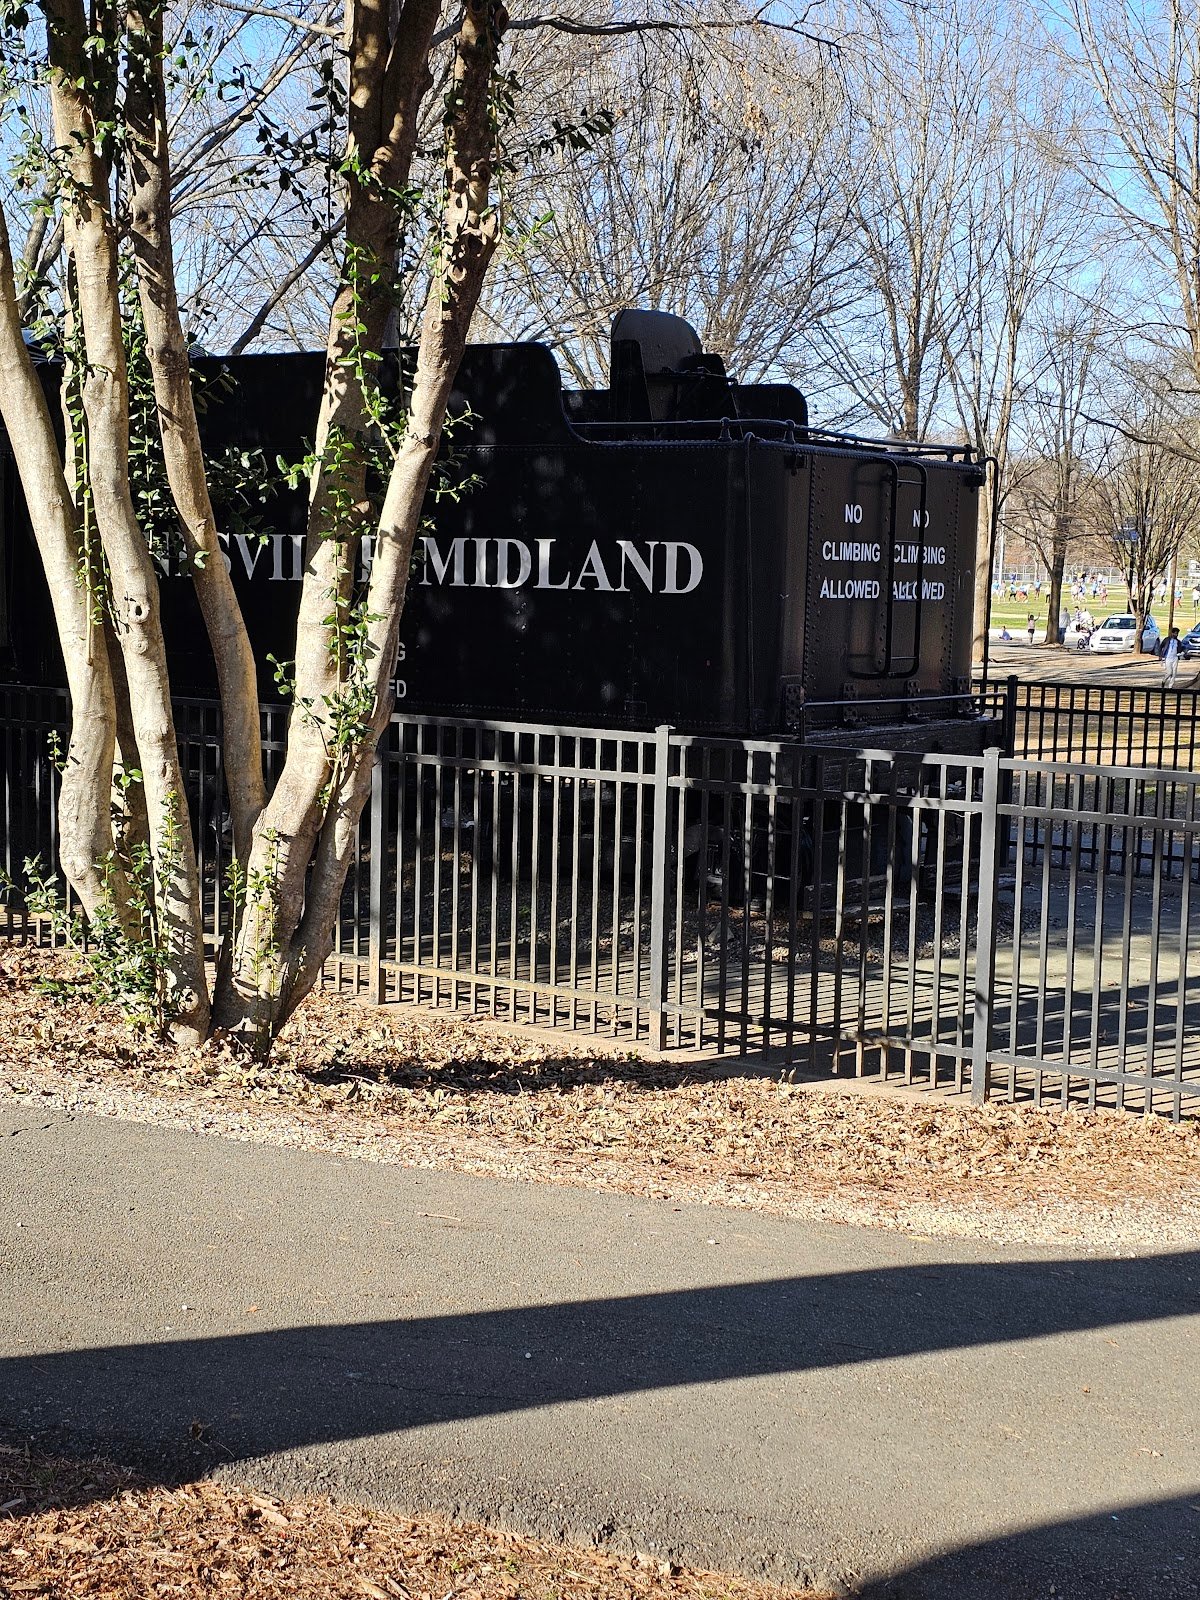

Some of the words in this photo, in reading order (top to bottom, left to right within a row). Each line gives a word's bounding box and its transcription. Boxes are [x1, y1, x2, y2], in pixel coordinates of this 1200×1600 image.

[844, 504, 863, 524] NO
[822, 541, 881, 562] CLIMBING
[418, 536, 704, 594] MIDLAND
[819, 577, 880, 599] ALLOWED
